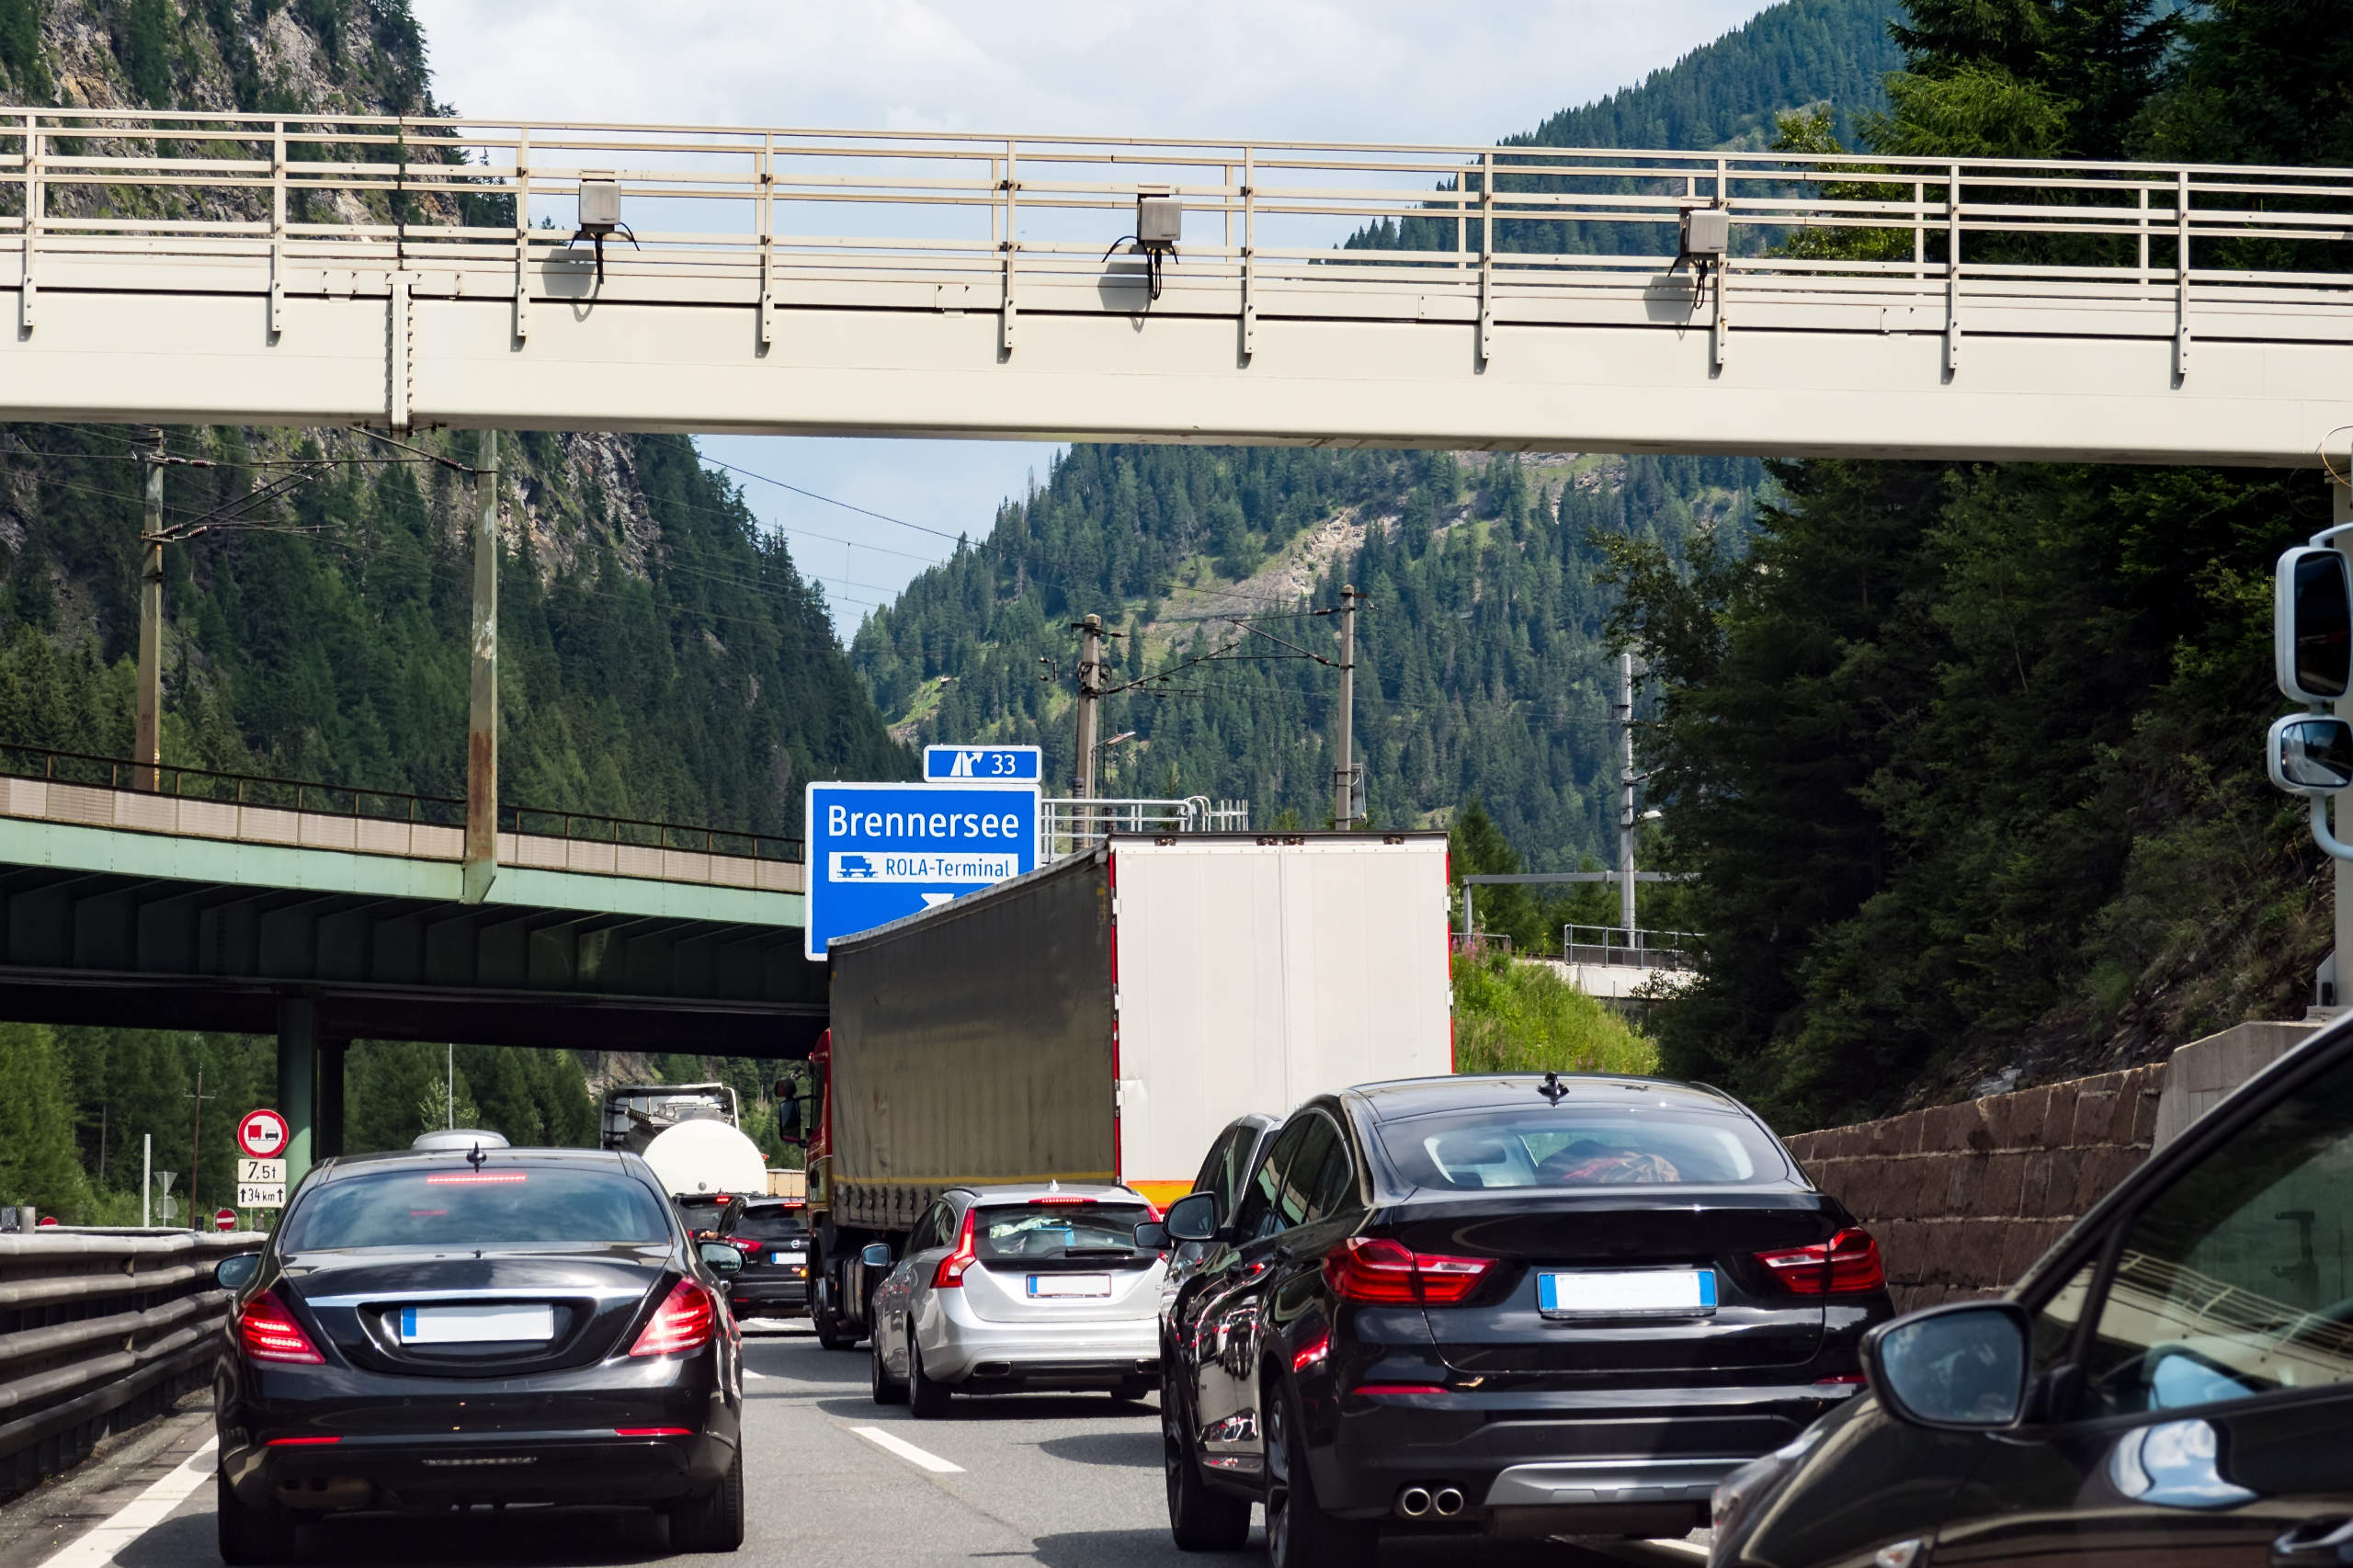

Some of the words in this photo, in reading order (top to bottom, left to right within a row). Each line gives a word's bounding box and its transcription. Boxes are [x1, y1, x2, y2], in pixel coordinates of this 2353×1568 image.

[991, 754, 1016, 775] 33
[828, 805, 1019, 838] Brennersee
[885, 858, 1010, 878] ROLA-Terminal
[248, 1187, 260, 1201] 34
[262, 1190, 275, 1201] km
